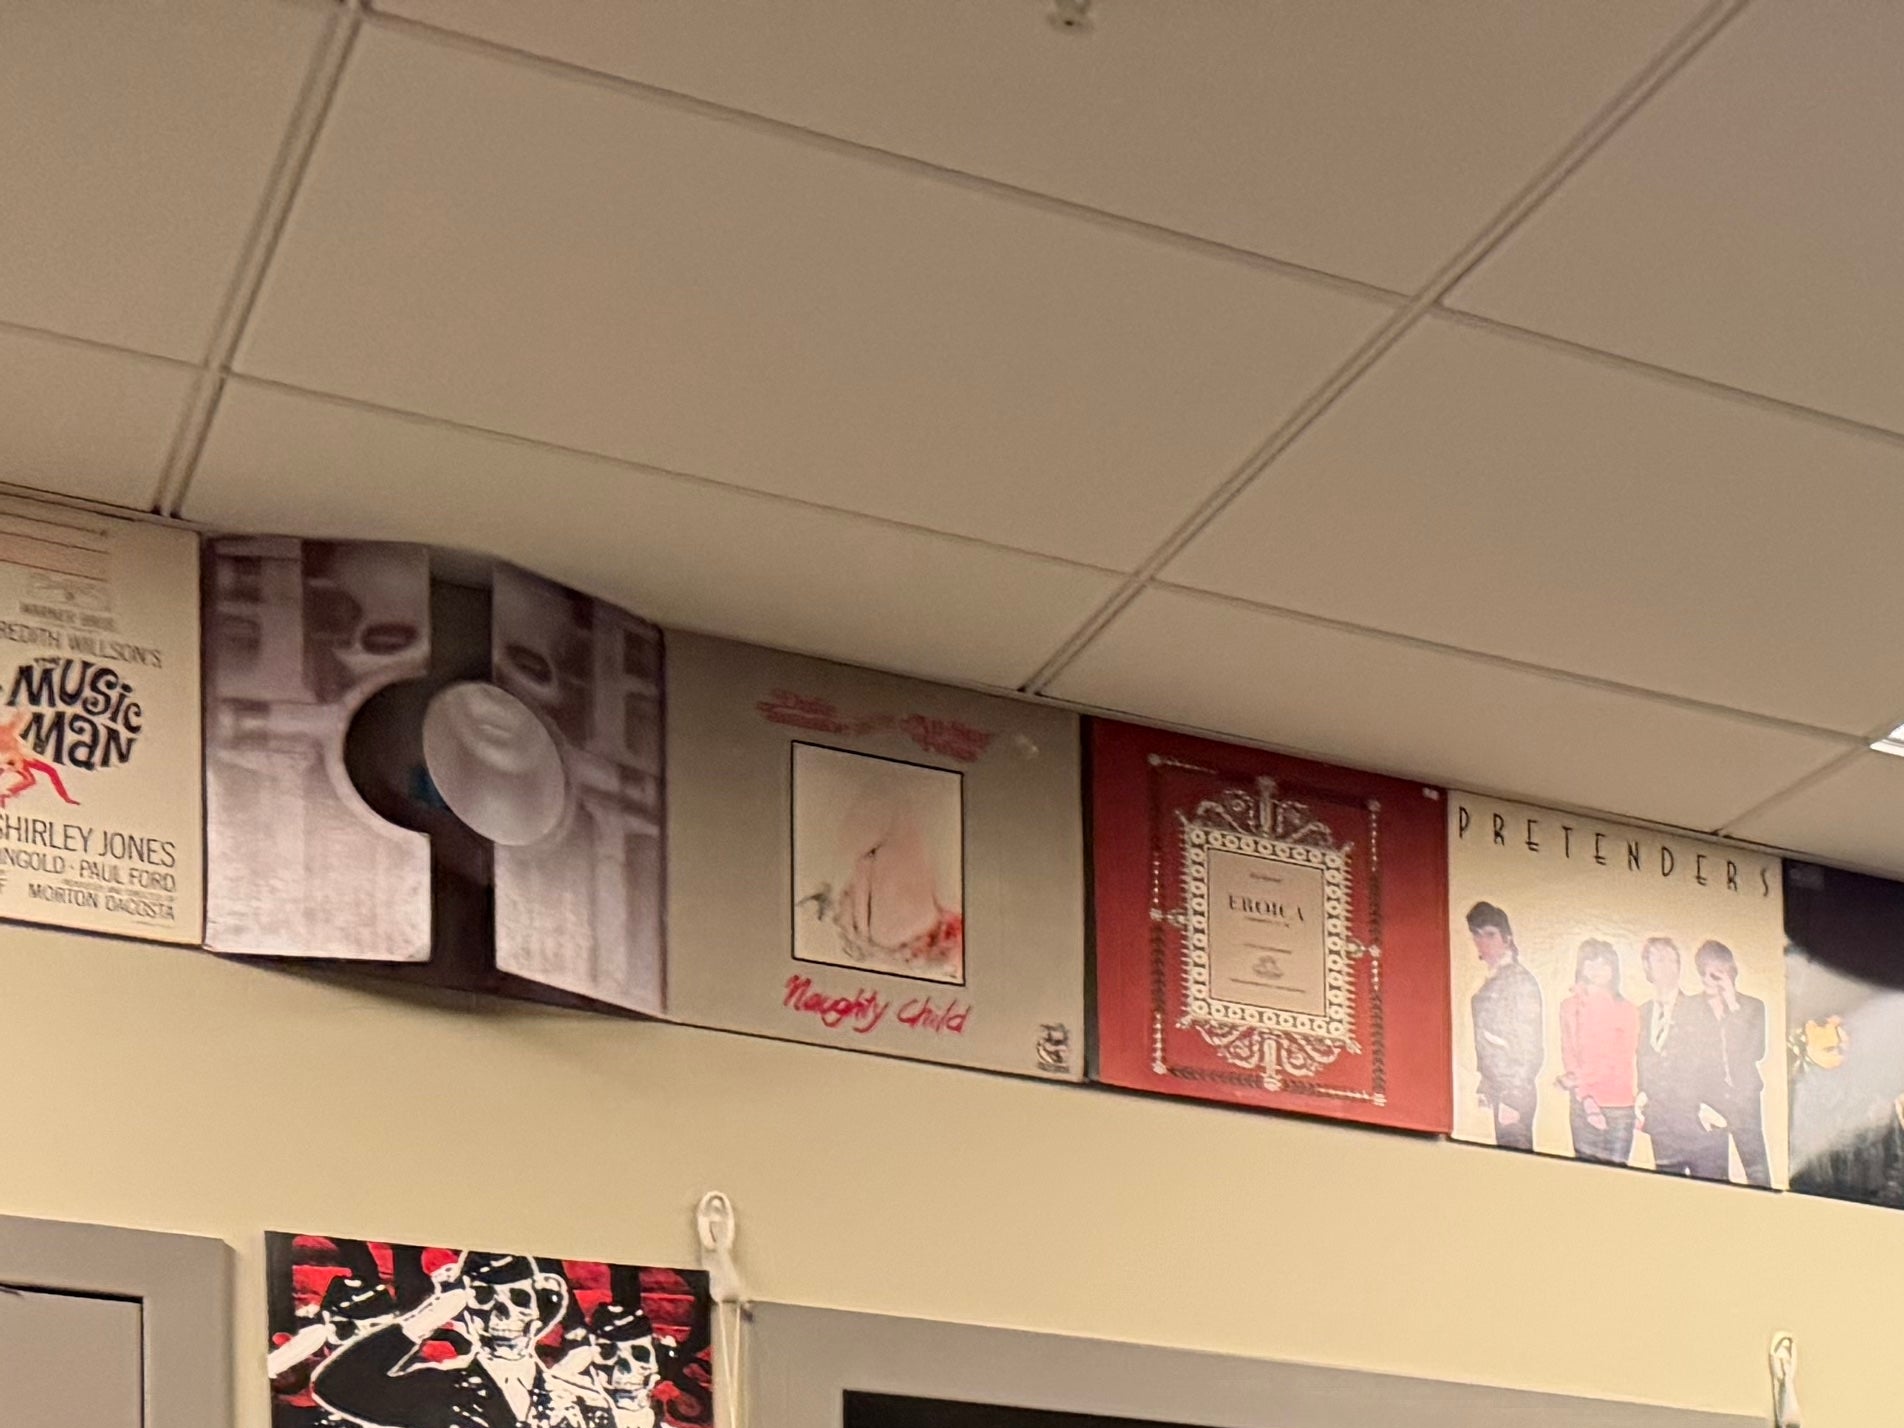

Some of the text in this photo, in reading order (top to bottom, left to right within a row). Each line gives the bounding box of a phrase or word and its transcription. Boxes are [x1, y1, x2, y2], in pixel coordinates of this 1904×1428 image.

[99, 830, 176, 868] JONES
[1458, 805, 1769, 897] PRETENDERS
[79, 859, 125, 886] PAUL
[129, 867, 176, 892] FORD
[29, 883, 98, 908] MORTON
[897, 996, 972, 1034] Child
